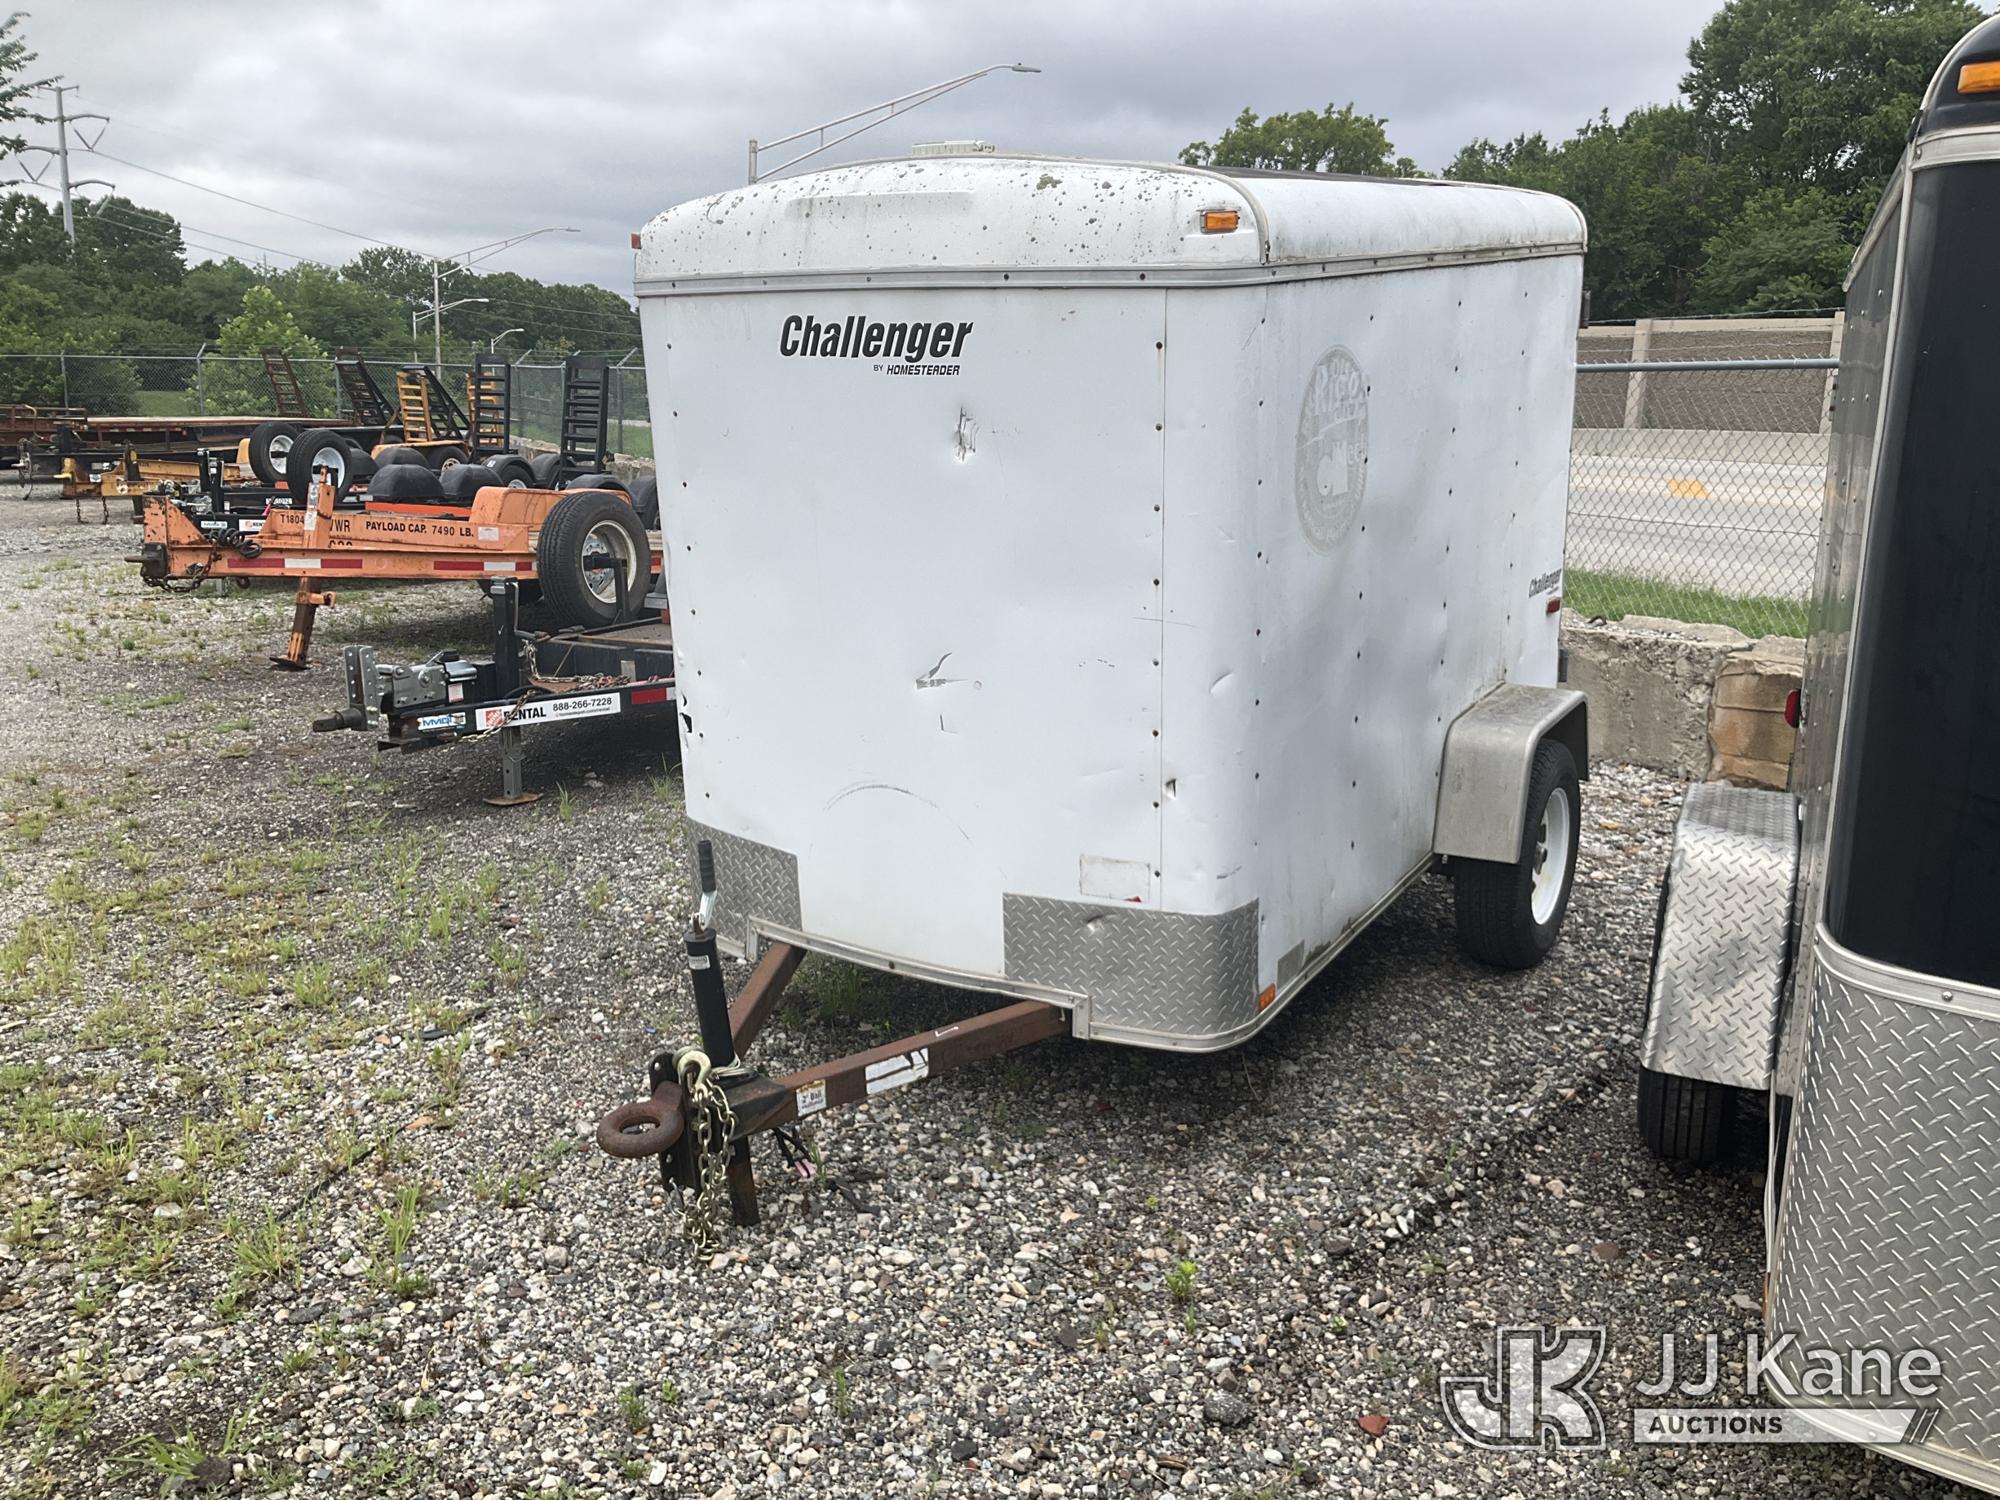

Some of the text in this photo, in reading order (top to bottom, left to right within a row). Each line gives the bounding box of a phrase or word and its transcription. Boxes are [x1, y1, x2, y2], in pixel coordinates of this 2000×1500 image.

[779, 314, 974, 363] Challenger
[873, 364, 961, 376] BY HOMESTEADER
[366, 520, 406, 533] PAYLOAD
[408, 523, 428, 534] CAP.
[431, 525, 455, 536] 7490
[459, 528, 474, 537] LB.
[552, 697, 613, 712] 888-266-7228
